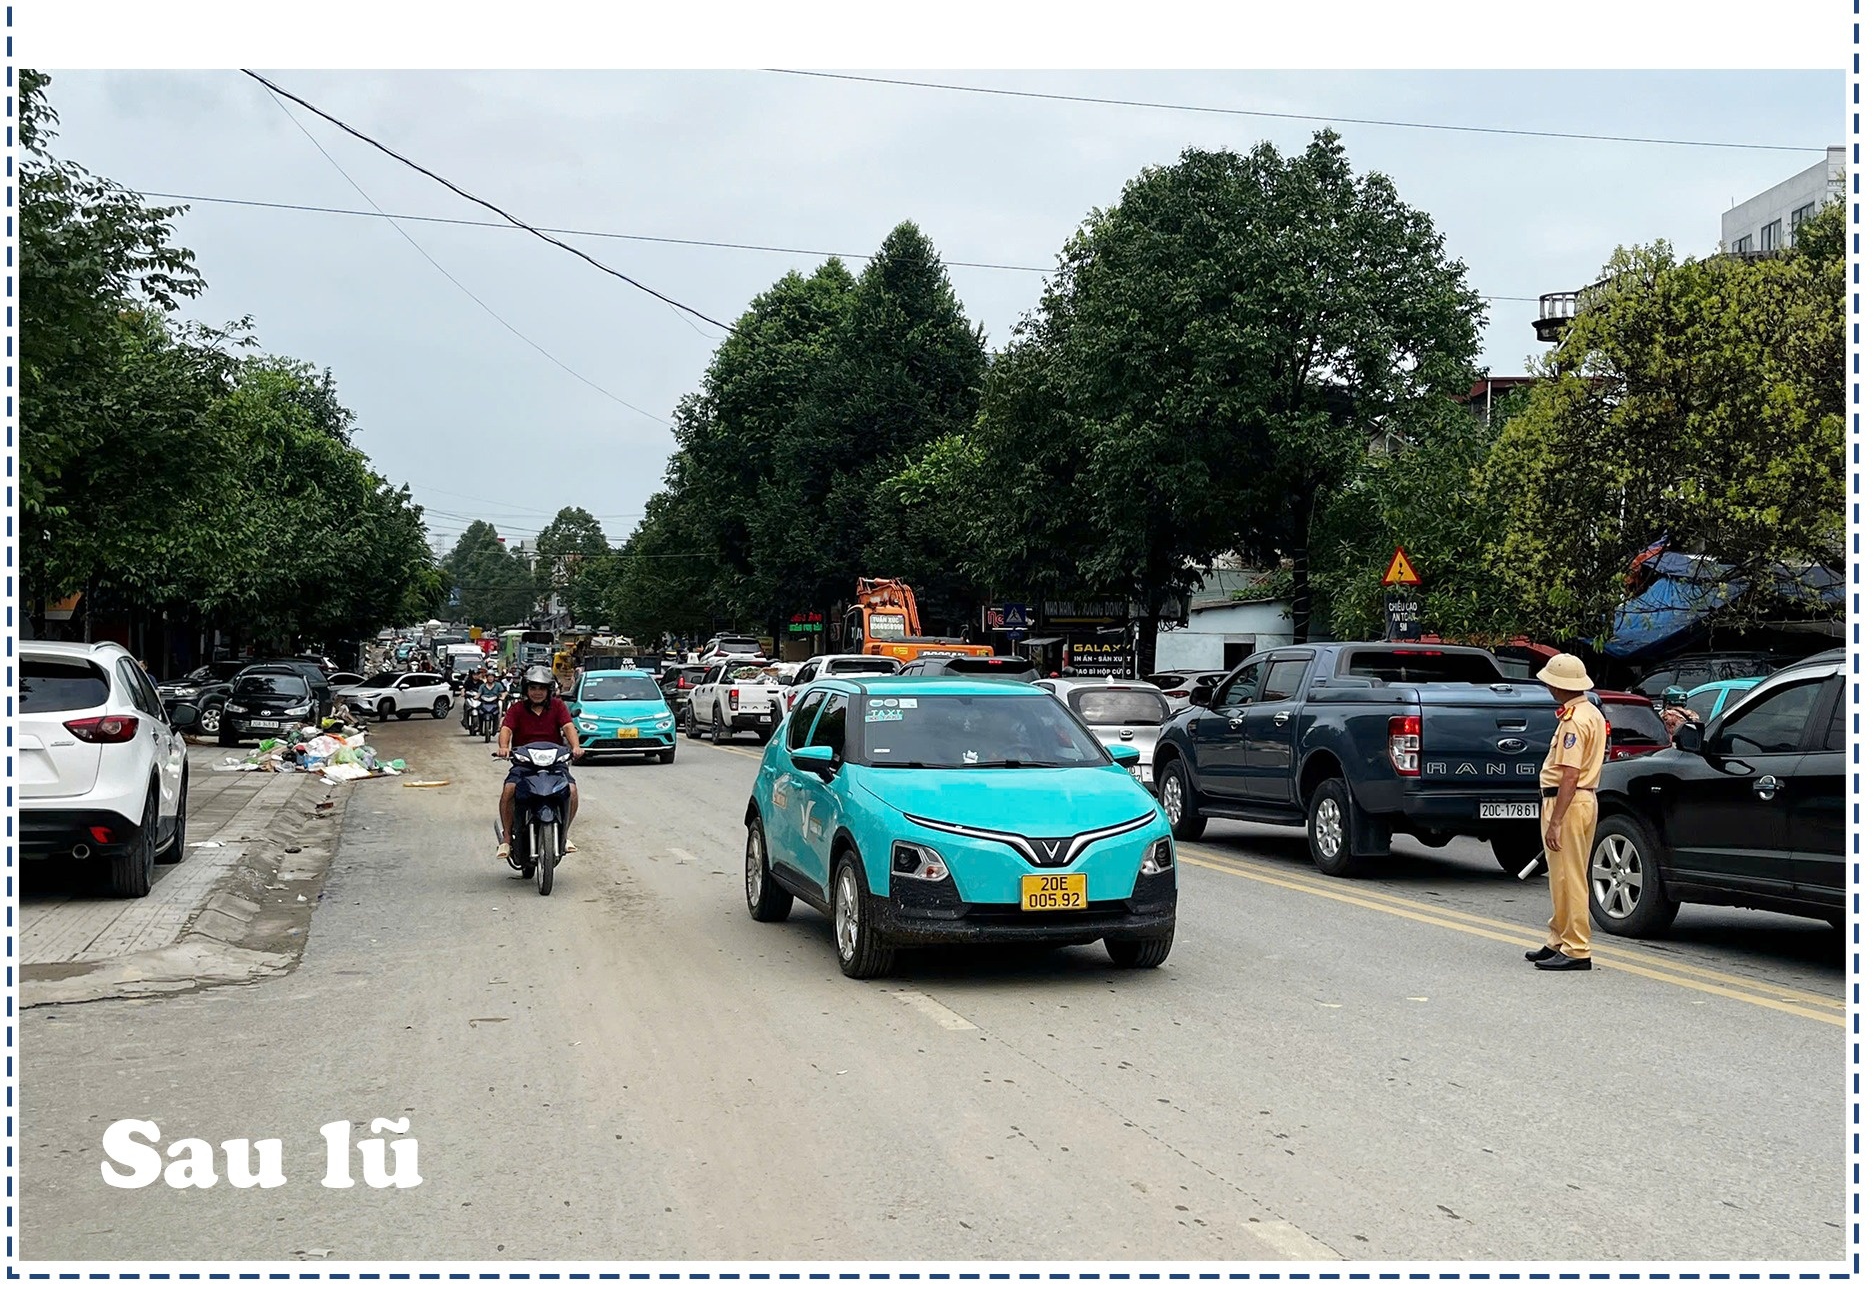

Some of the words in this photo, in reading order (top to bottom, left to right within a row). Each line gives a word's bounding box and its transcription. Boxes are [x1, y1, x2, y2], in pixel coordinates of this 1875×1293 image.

[1112, 667, 1131, 675] CỨG
[1426, 762, 1536, 775] RANG
[1040, 876, 1068, 892] 20E
[1029, 892, 1081, 908] 005.92
